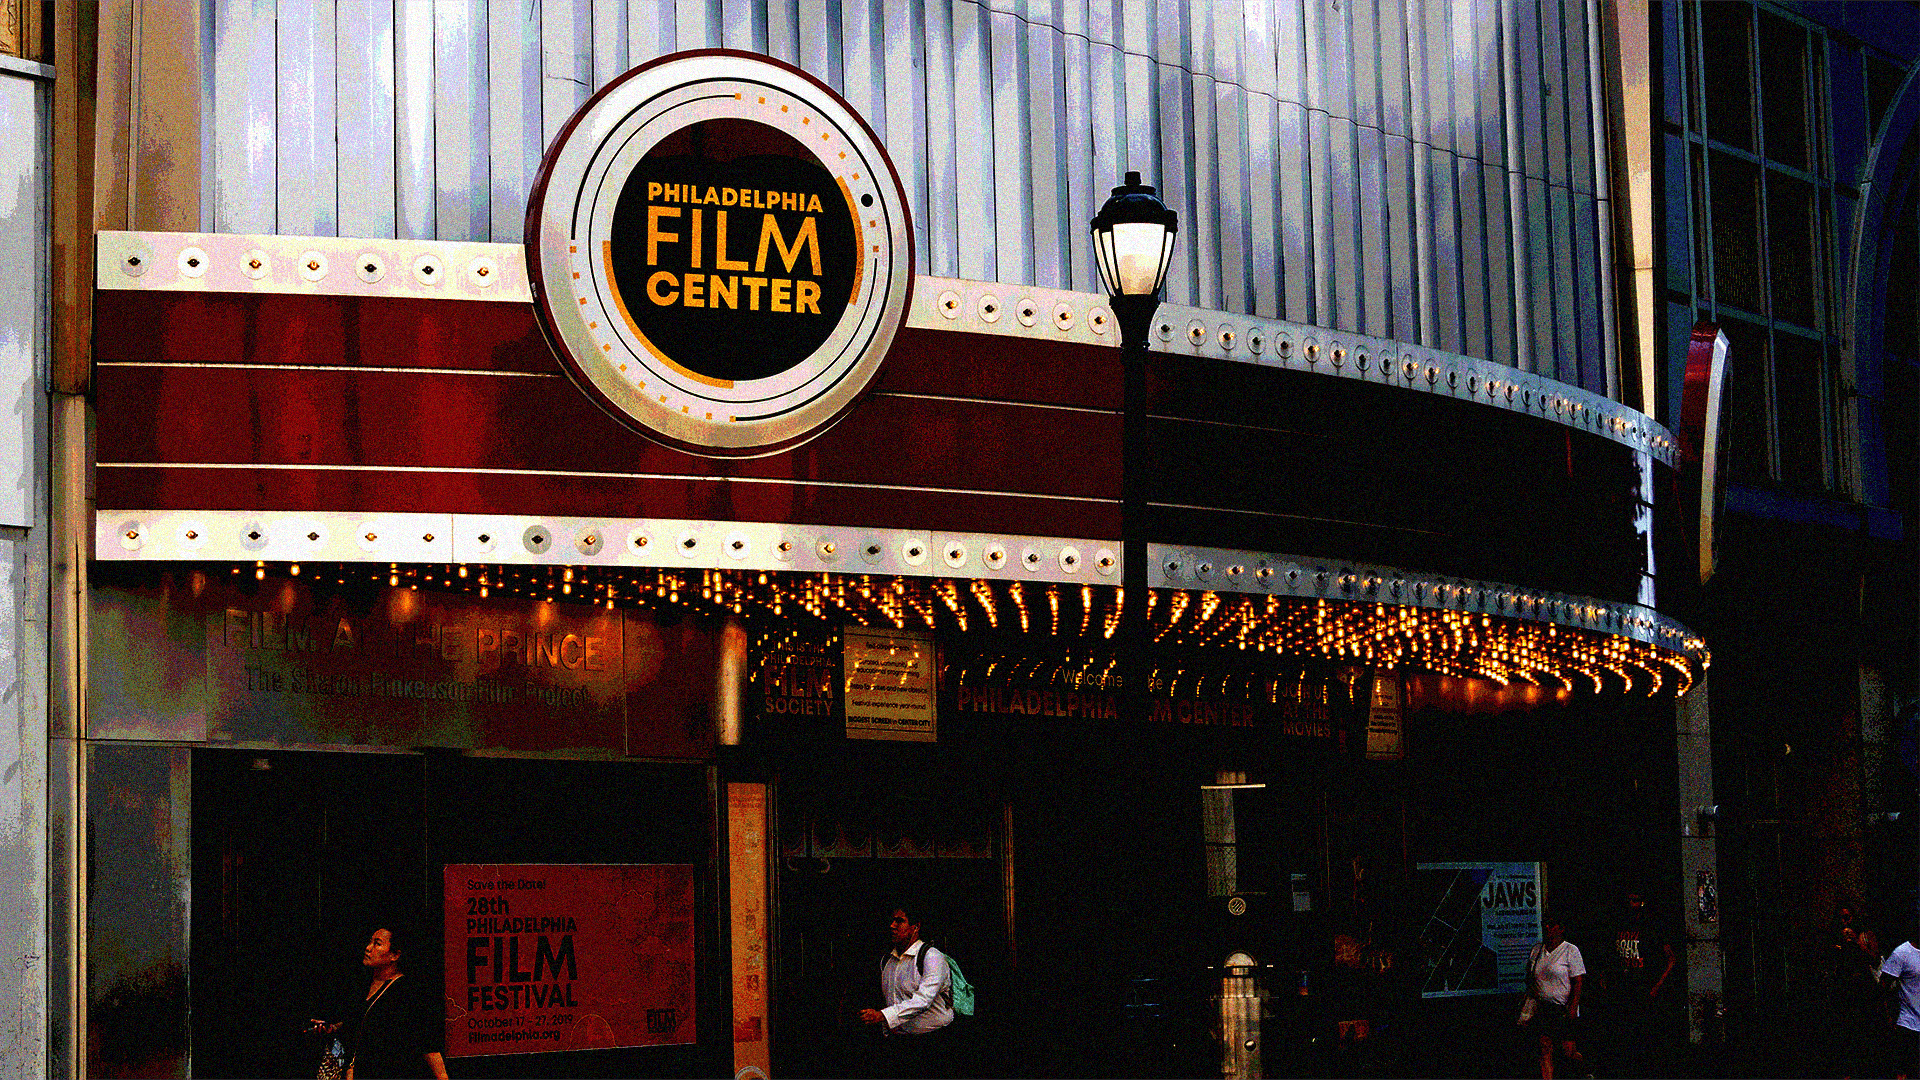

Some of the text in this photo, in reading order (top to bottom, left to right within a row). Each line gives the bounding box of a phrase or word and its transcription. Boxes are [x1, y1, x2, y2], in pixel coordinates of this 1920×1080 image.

[648, 182, 823, 213] PHILADELPHIA
[647, 206, 823, 276] FILM
[646, 271, 821, 314] CENTER
[224, 608, 316, 653] FILM
[477, 627, 604, 672] PRINCE
[764, 653, 833, 667] PHILDELPHIA
[244, 664, 282, 692] The
[764, 665, 833, 699] FILM
[1062, 668, 1163, 690] Welcome he
[765, 696, 834, 716] SOCIETY
[957, 685, 1119, 719] PHILADELPHIA
[1177, 698, 1253, 727] CENTER
[1301, 702, 1330, 720] THE
[1283, 720, 1331, 737] MOVIES
[467, 879, 546, 890] Save the Date!
[1483, 881, 1536, 908] JAWS
[467, 895, 510, 915] 28th
[467, 916, 578, 934] PHILADELPHIA
[466, 934, 578, 984] FILM
[467, 983, 579, 1011] FESTIVAL
[467, 1017, 512, 1029] October
[516, 1016, 525, 1027] 17
[552, 1013, 574, 1026] 2019
